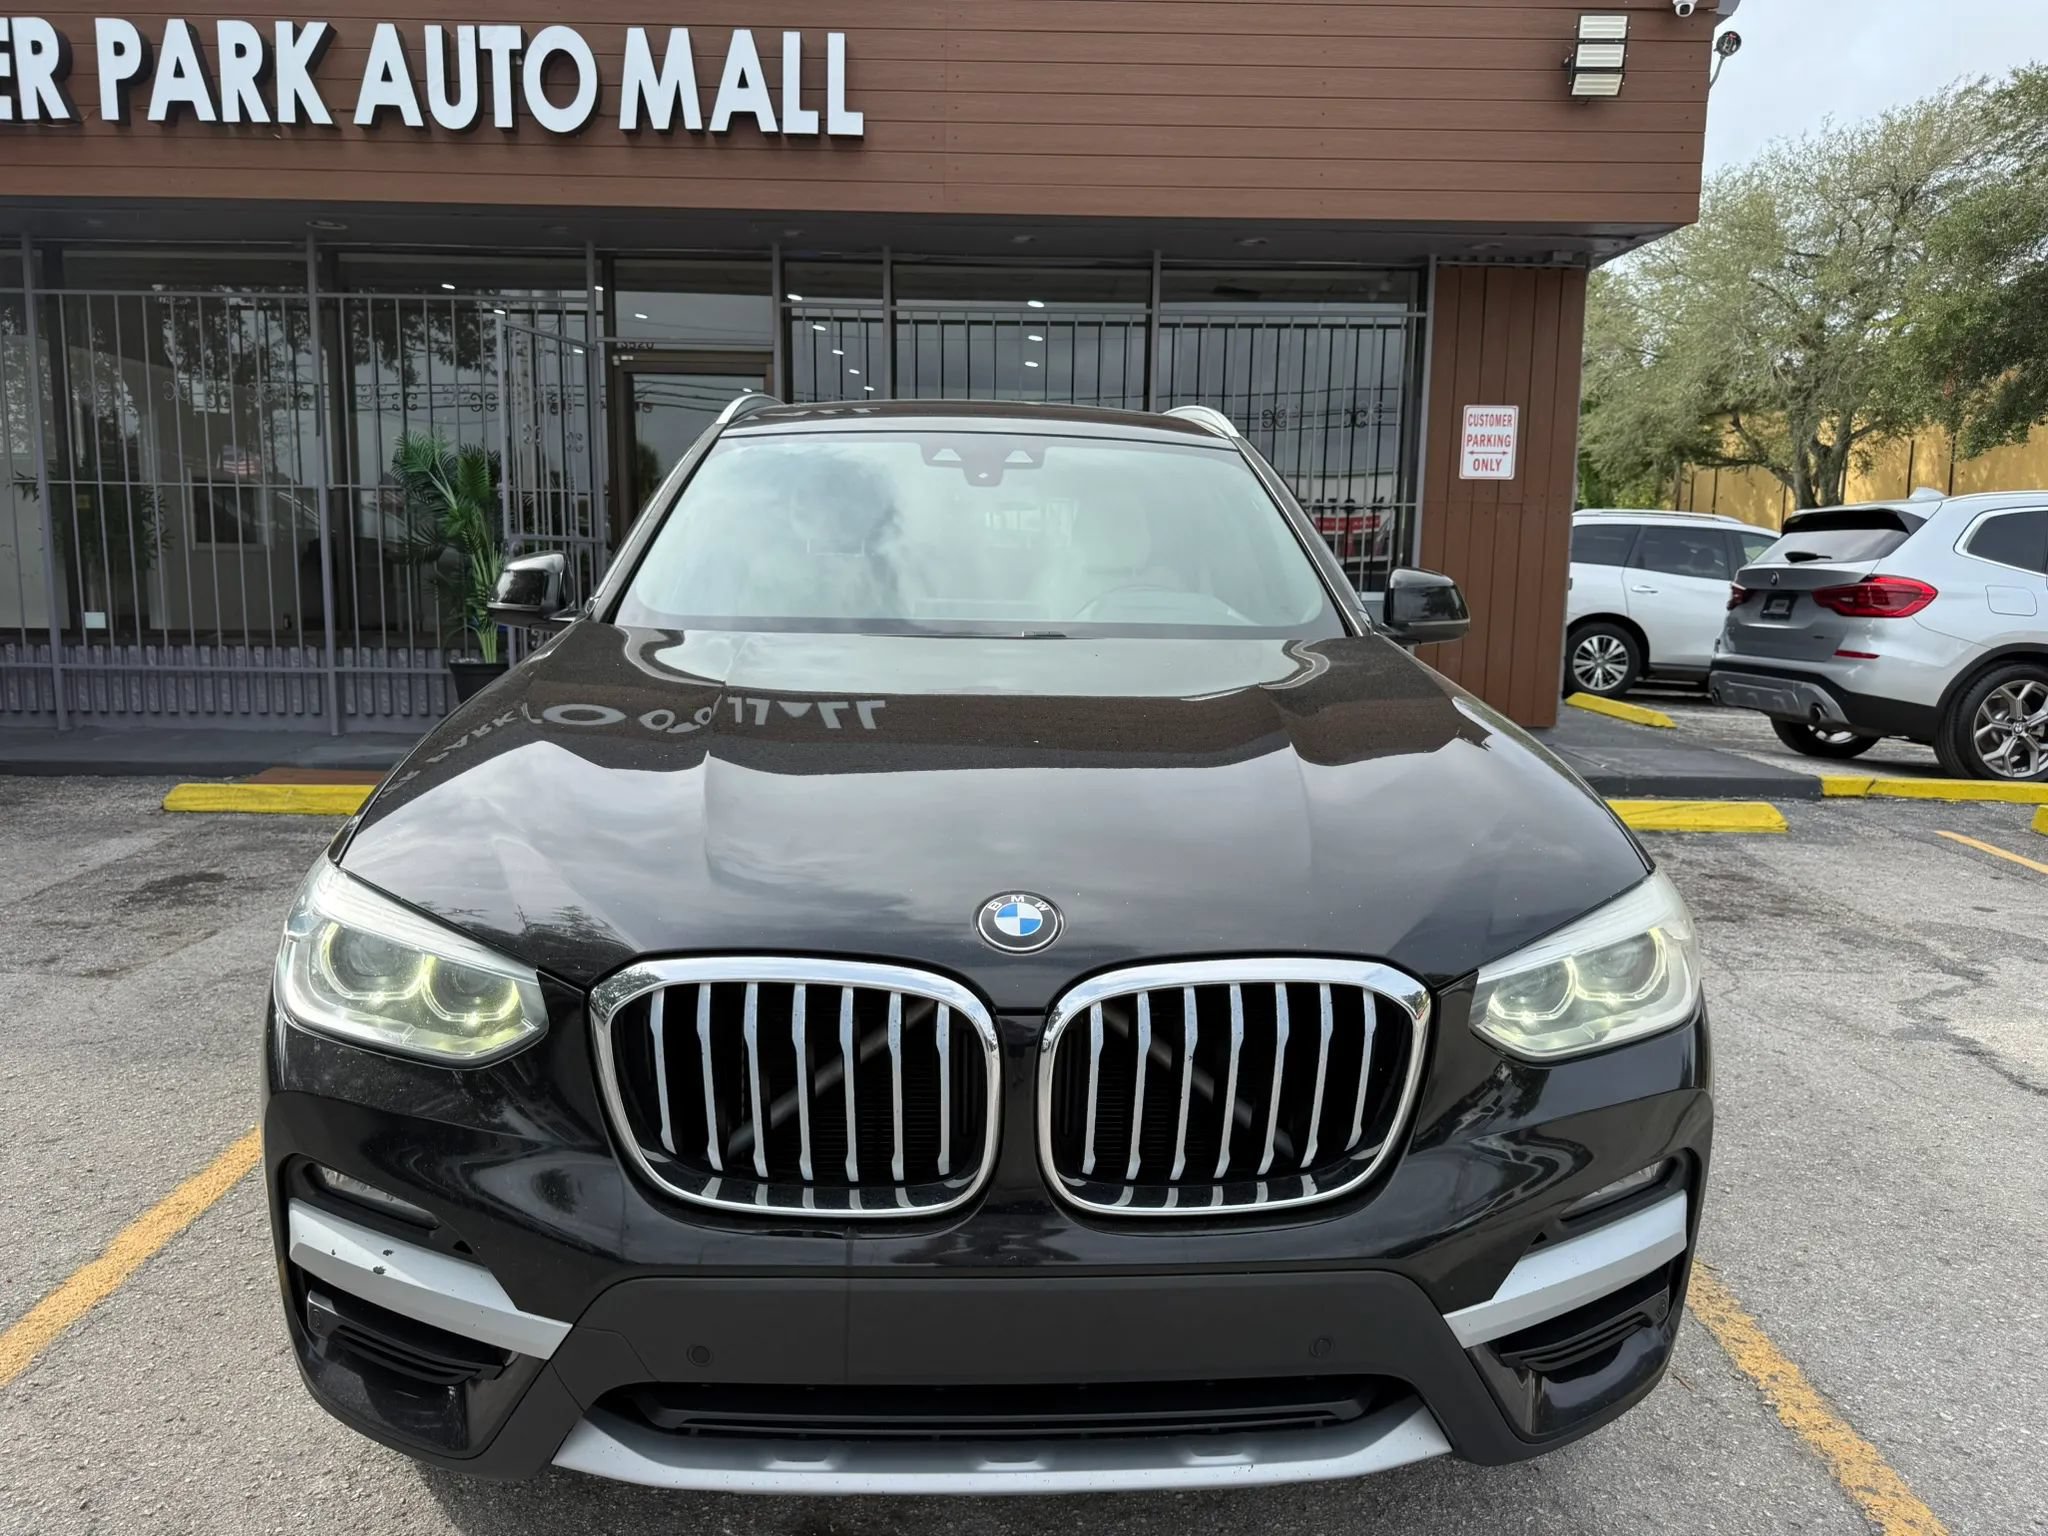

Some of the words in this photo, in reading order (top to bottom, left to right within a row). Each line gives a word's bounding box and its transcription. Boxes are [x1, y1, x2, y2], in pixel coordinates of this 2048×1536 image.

[94, 18, 333, 126] PARK
[353, 23, 598, 134] AUTO
[618, 27, 864, 136] MALL
[1467, 414, 1513, 427] CUSTOMER
[1466, 434, 1511, 447] PARKING
[1473, 458, 1502, 471] ONLY
[987, 895, 1050, 912] BMW
